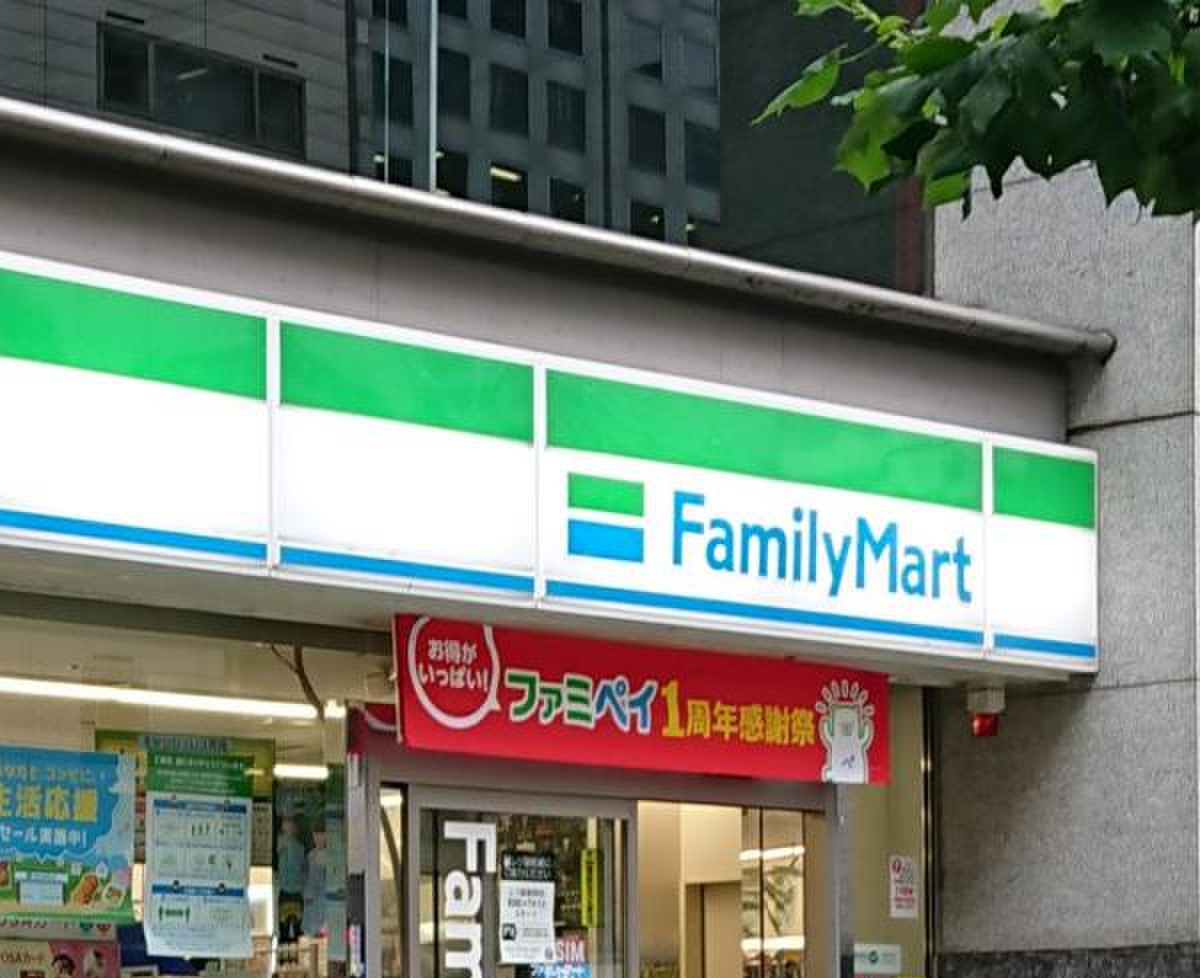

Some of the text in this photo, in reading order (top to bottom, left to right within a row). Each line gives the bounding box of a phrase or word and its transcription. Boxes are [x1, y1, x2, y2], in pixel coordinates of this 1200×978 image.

[672, 490, 973, 603] FamilyMart
[428, 637, 478, 665] お得が
